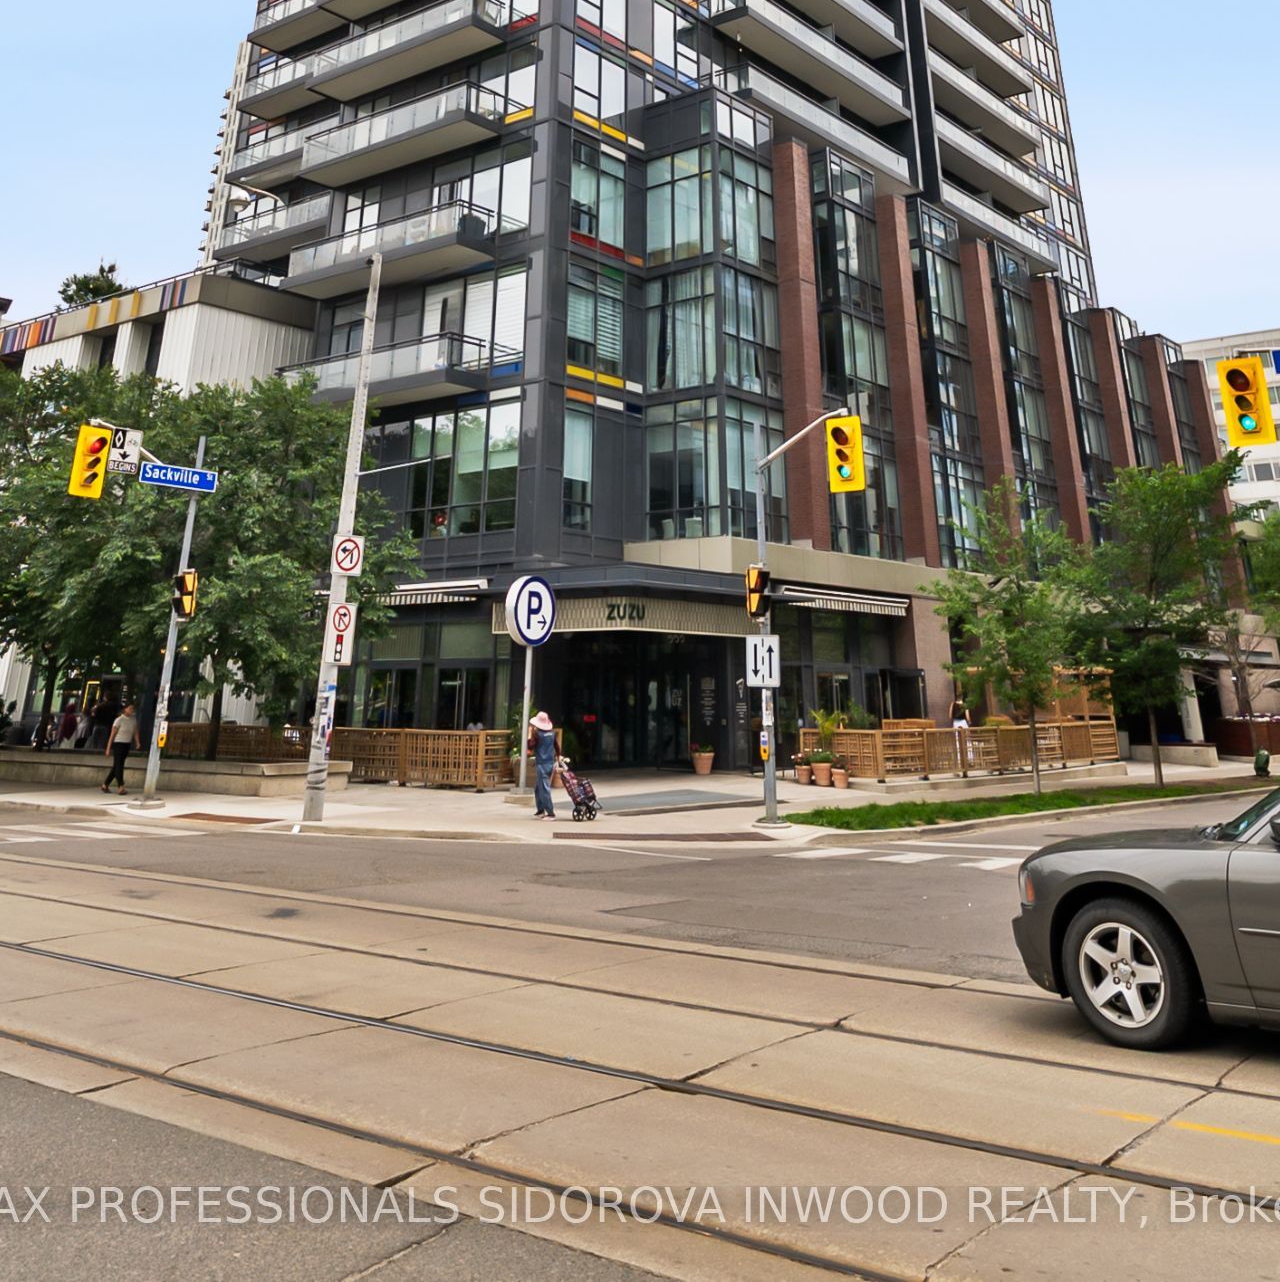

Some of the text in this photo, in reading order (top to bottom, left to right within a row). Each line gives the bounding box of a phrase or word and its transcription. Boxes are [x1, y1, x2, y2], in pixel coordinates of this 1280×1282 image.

[108, 460, 137, 473] BEGINS
[144, 464, 200, 485] Sackville
[526, 590, 543, 630] P
[606, 603, 646, 621] ZUZU
